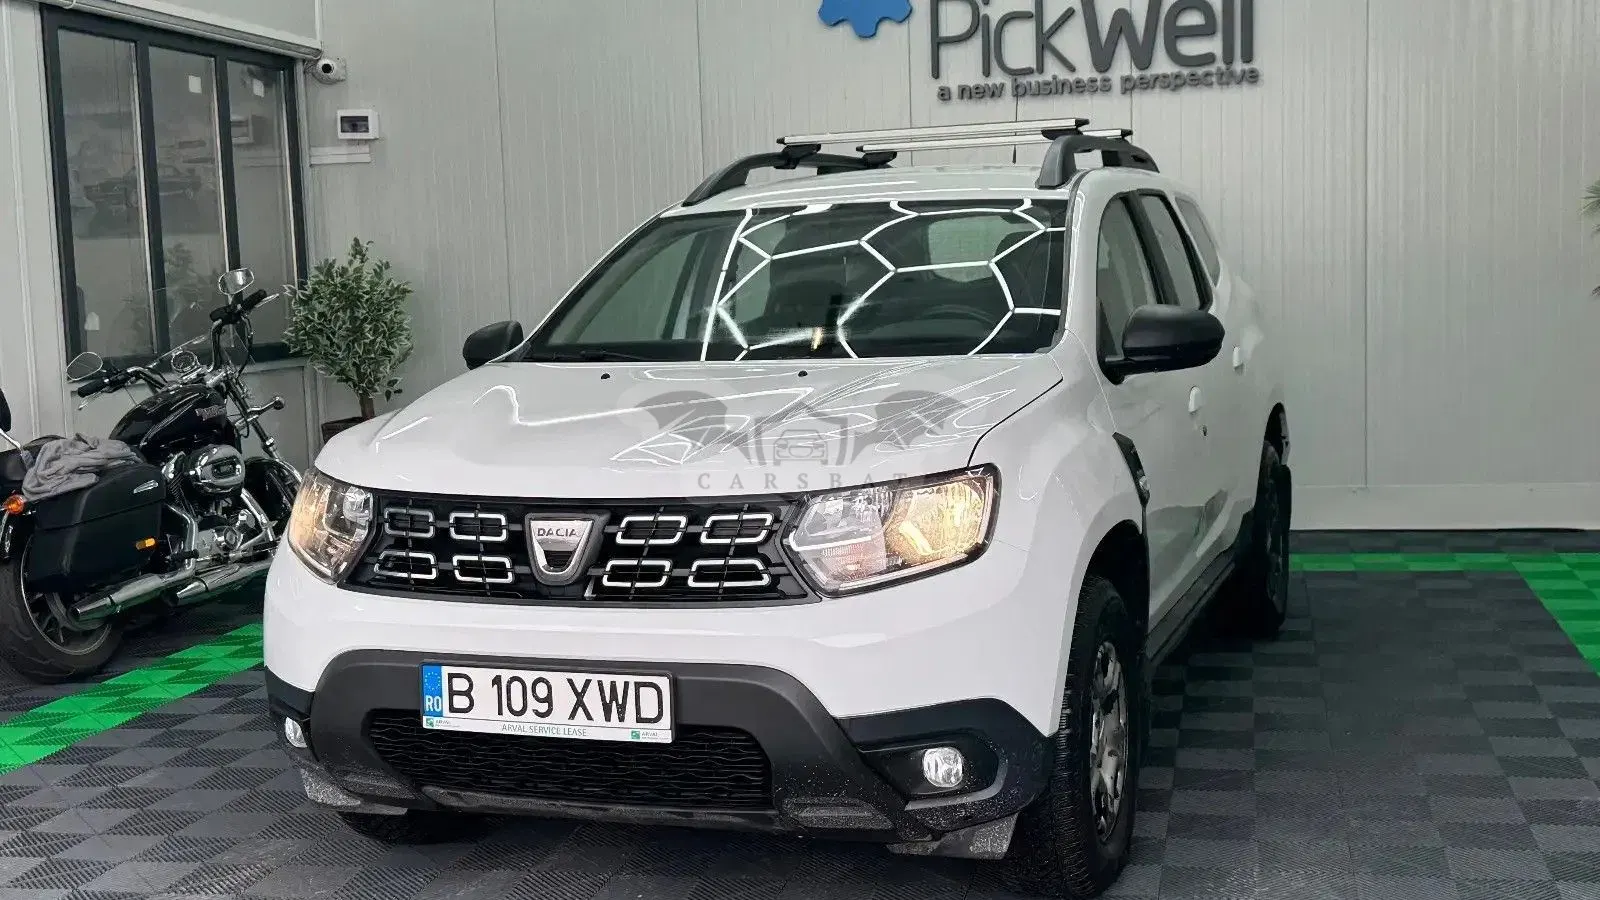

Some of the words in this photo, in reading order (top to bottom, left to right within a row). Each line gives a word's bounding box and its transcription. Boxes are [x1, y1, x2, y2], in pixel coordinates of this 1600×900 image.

[930, 0, 1254, 79] PickWell
[937, 85, 951, 101] a
[957, 80, 1004, 100] new
[1011, 73, 1111, 97] business
[1120, 66, 1259, 94] perspective
[537, 527, 578, 537] DACIA
[425, 695, 442, 712] RO
[447, 673, 475, 714] B
[491, 674, 554, 719] 109
[566, 678, 664, 724] XWD
[501, 723, 526, 733] ARVAL
[528, 725, 561, 735] SERVICE
[563, 727, 587, 737] LEASE
